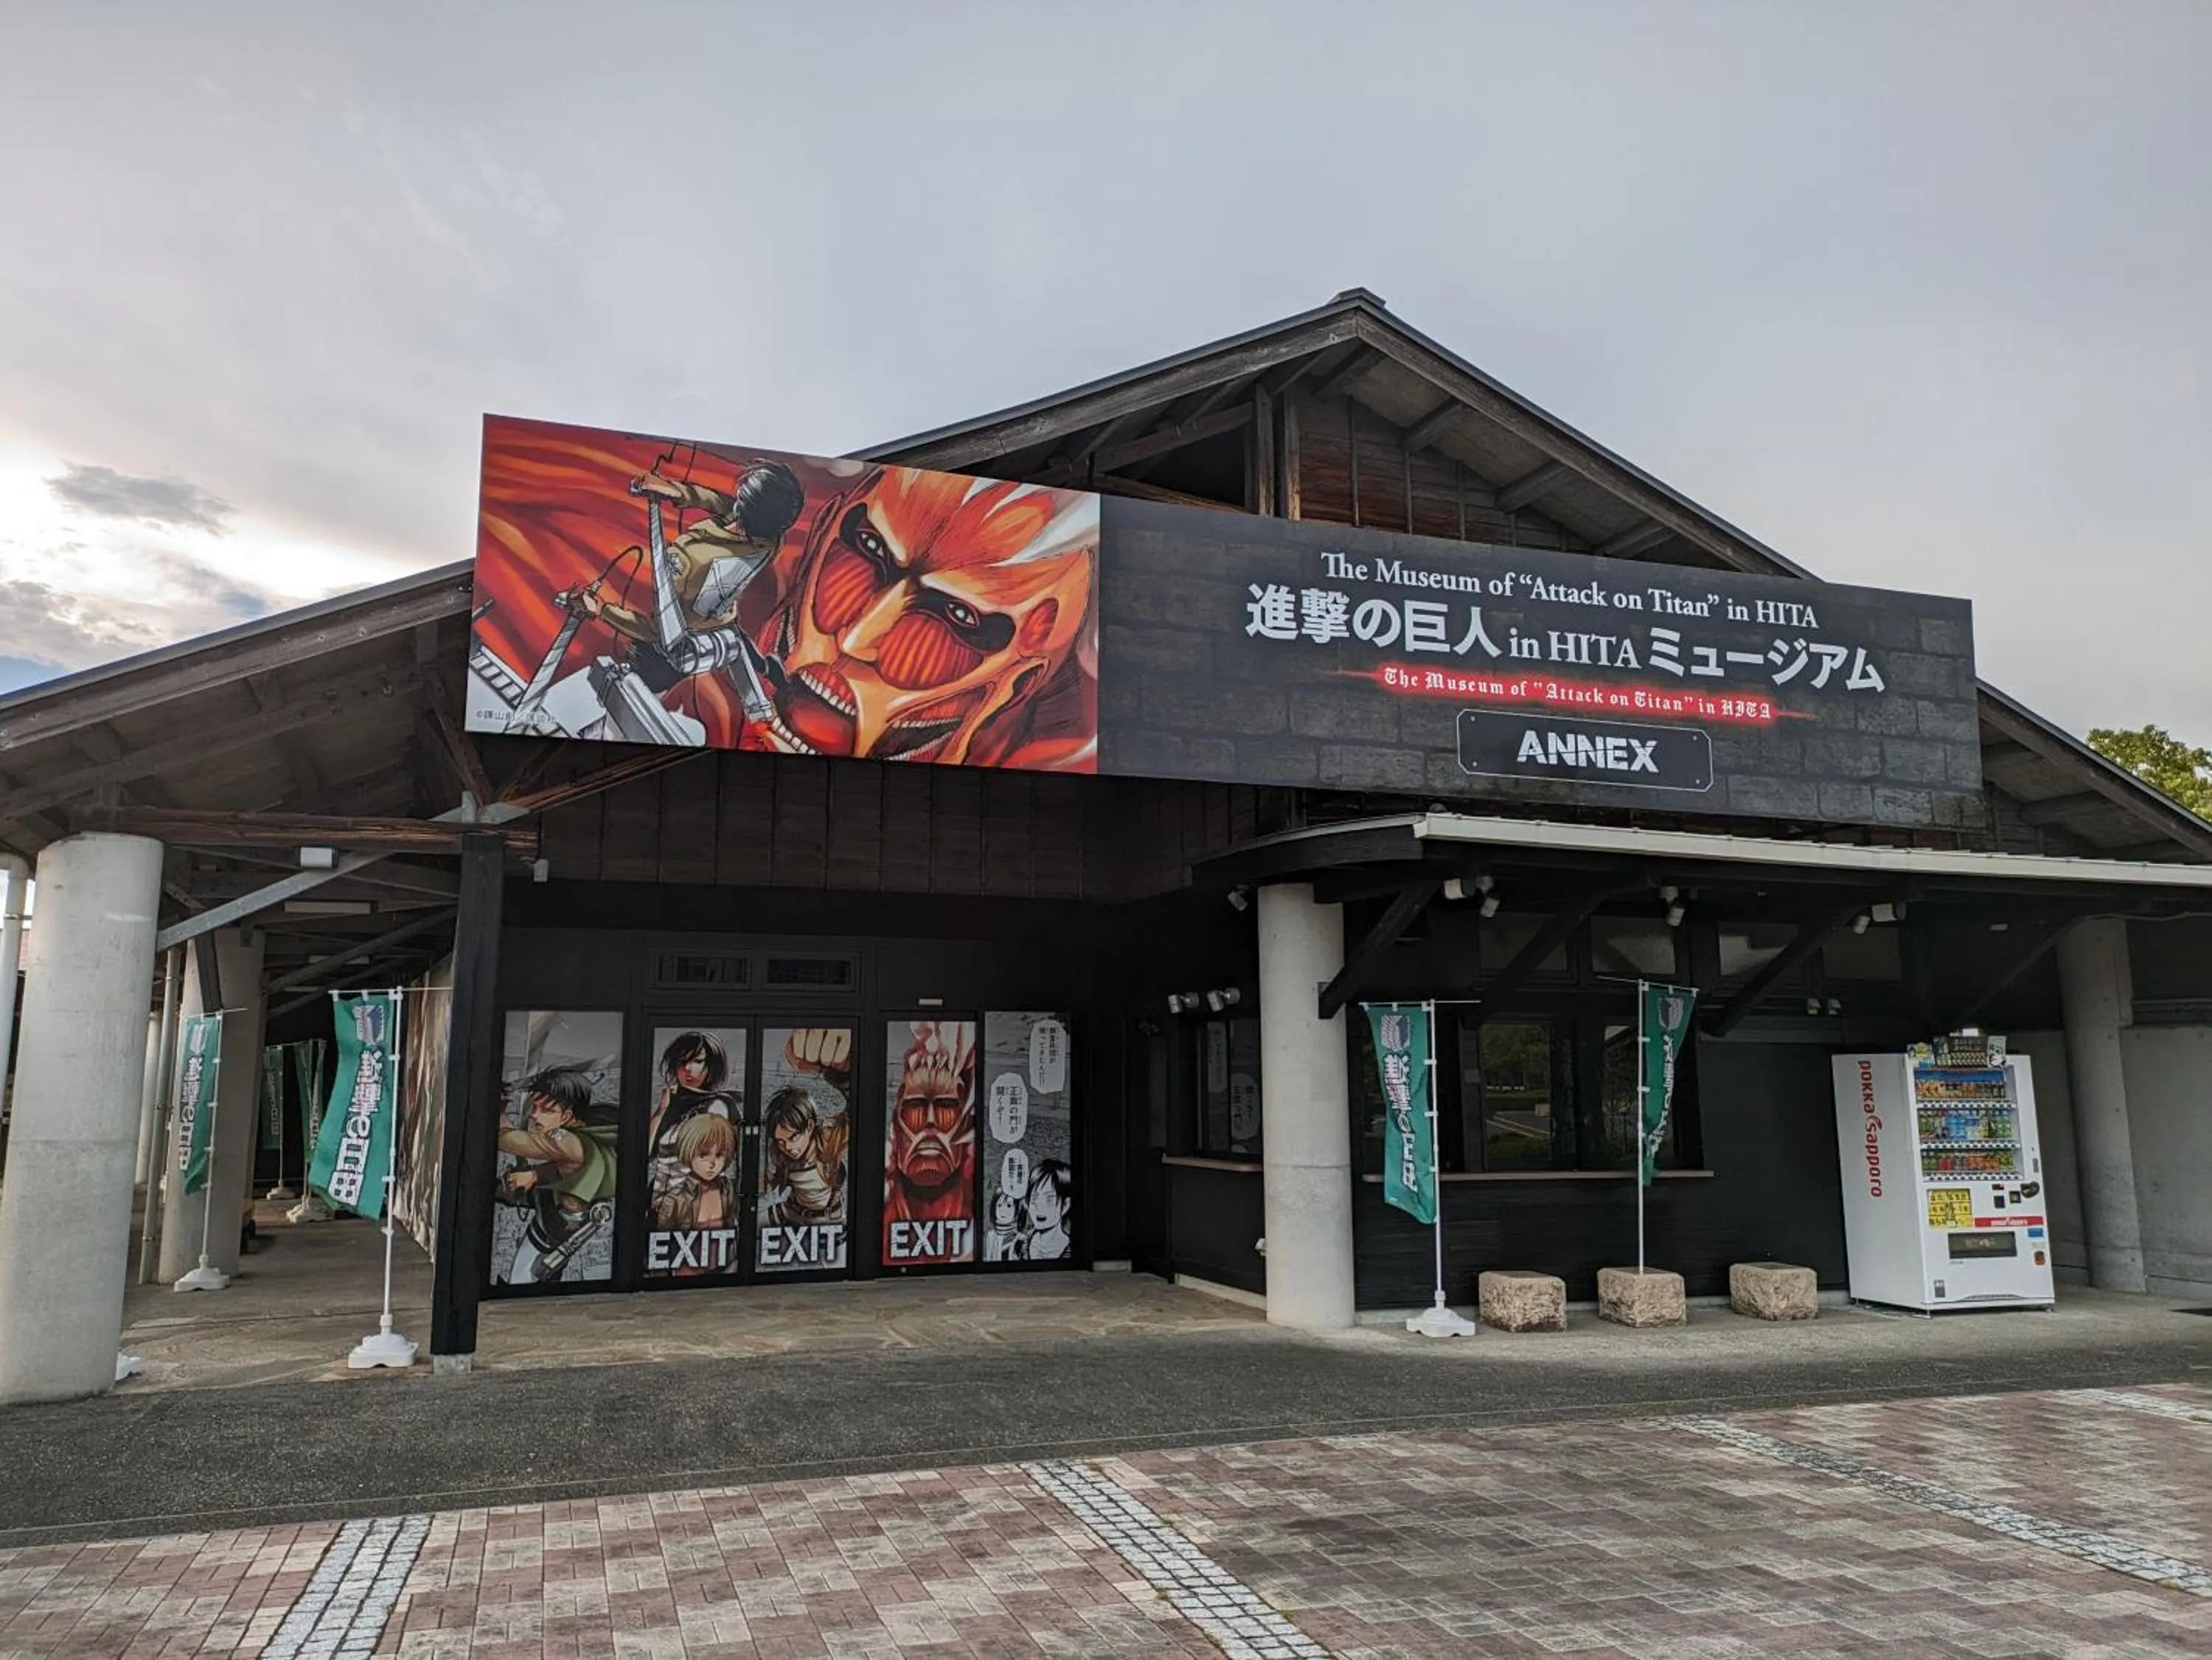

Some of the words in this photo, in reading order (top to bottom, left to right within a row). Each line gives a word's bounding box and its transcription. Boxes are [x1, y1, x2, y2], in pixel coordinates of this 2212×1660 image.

[1321, 553, 1368, 580] The
[1374, 558, 1481, 593] Museum
[1489, 572, 1515, 596] of
[1613, 590, 1643, 610] on
[1728, 599, 1750, 621] in
[1755, 599, 1819, 629] HITA
[1245, 583, 1502, 658] 進撃の巨人
[1509, 627, 1542, 660] in
[1547, 630, 1643, 669] HITA
[1649, 627, 1886, 693] ミュージアム
[1384, 667, 1418, 687] The
[1425, 671, 1504, 695] Museum
[1511, 681, 1528, 697] of
[1610, 692, 1629, 706] on
[1698, 698, 1715, 714] in
[1721, 699, 1770, 719] HITA
[1517, 729, 1659, 773] ANNEX
[648, 1229, 735, 1269] EXIT
[760, 1224, 843, 1264] EXIT
[889, 1219, 967, 1258] EXIT
